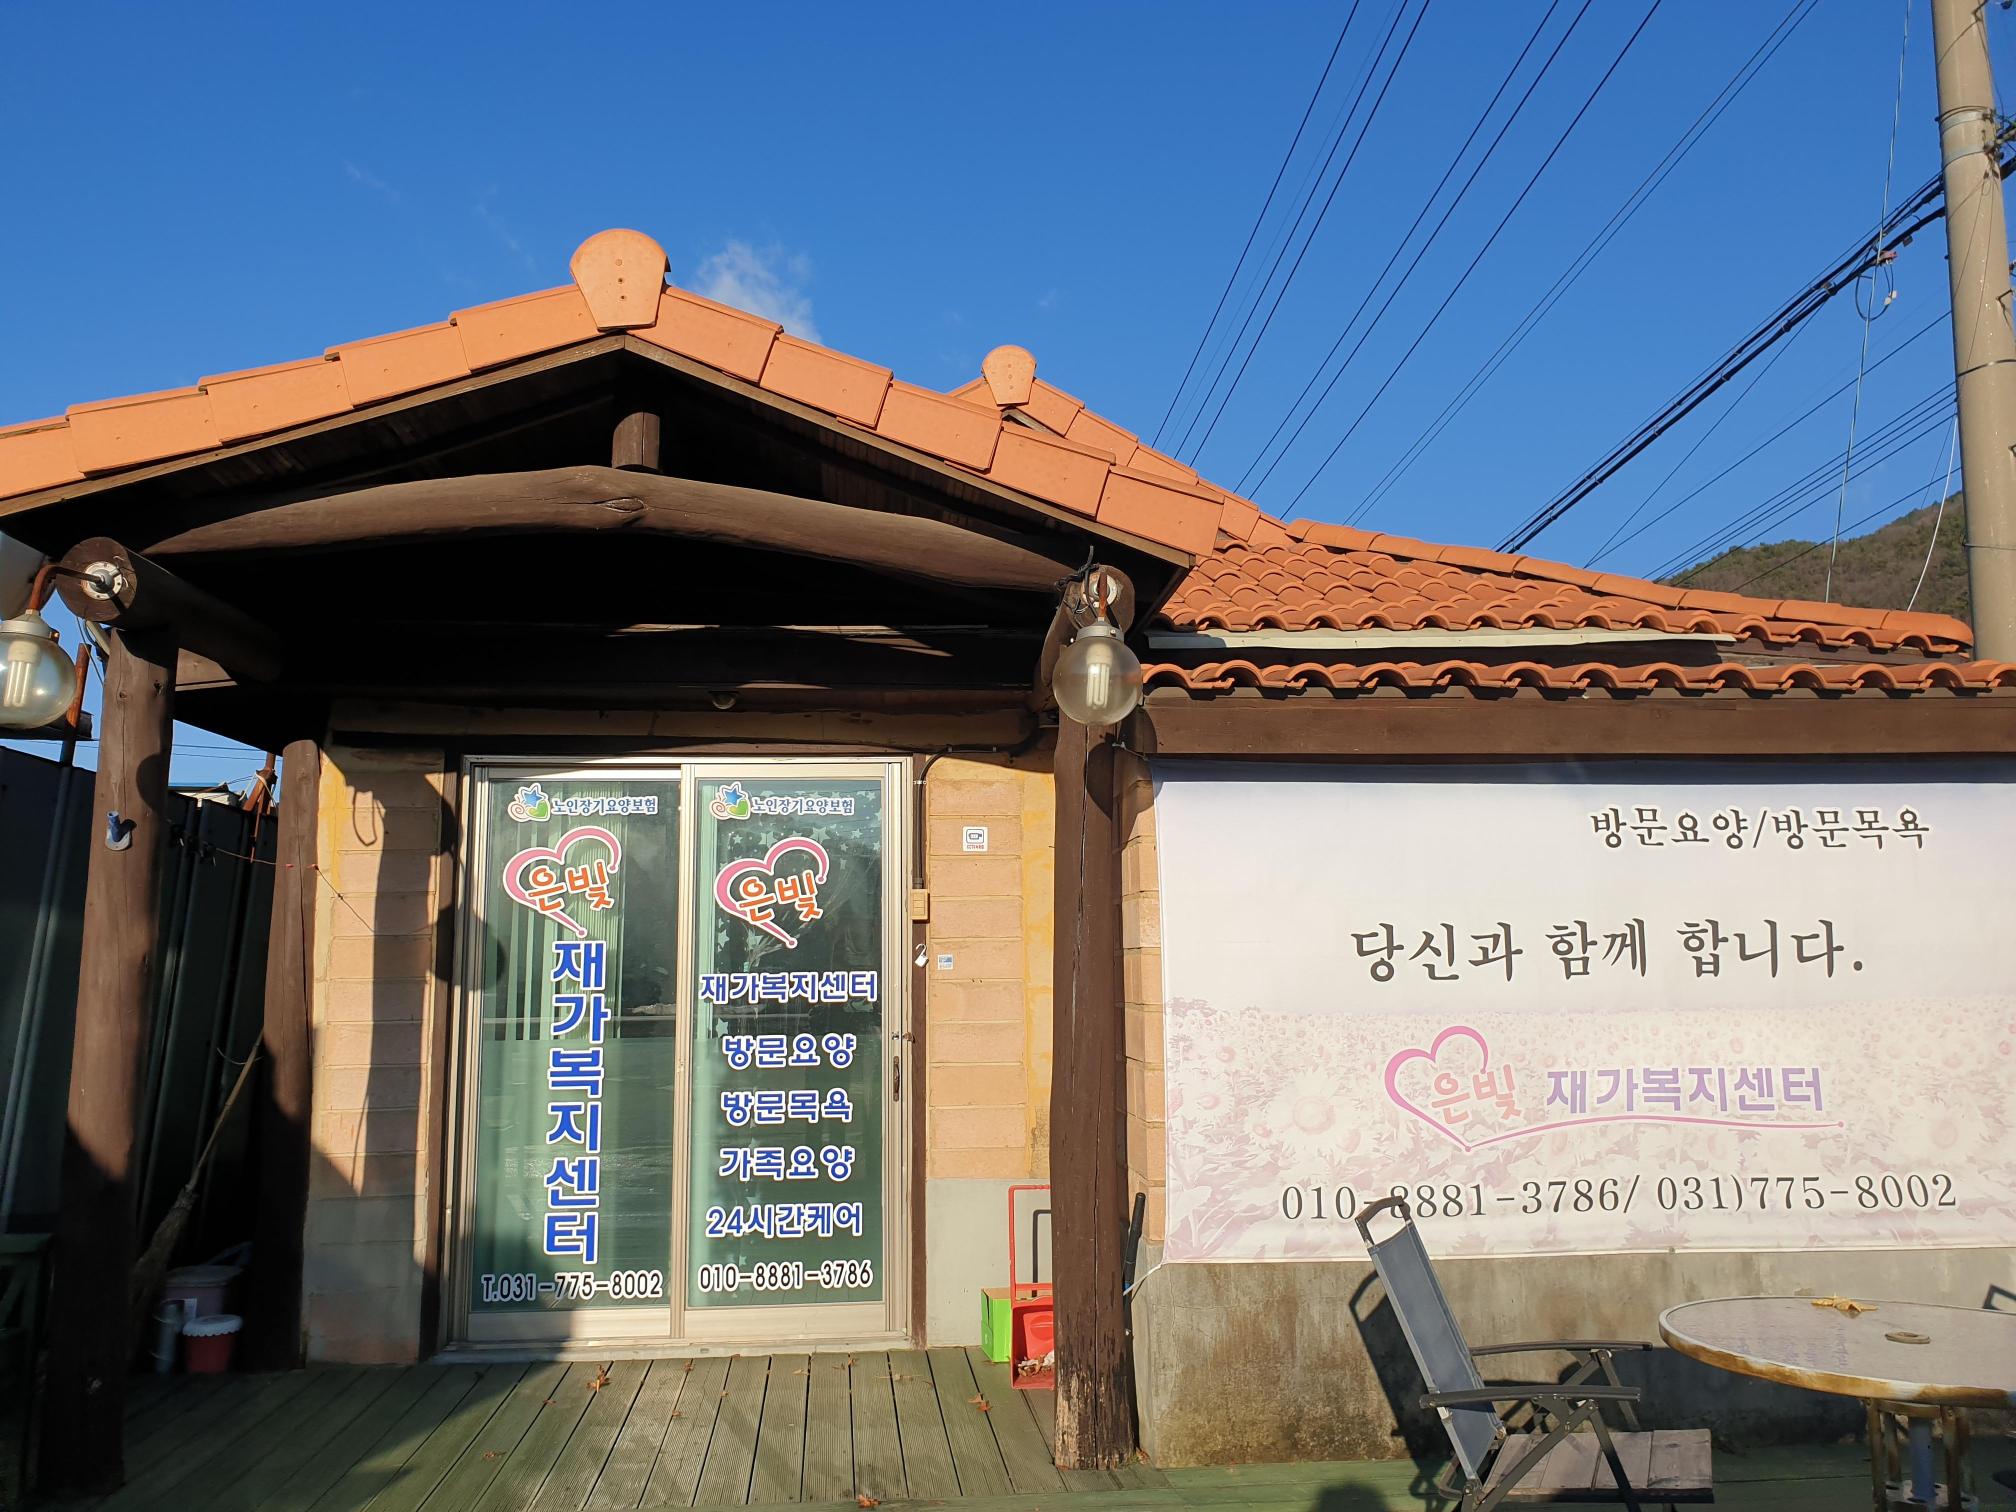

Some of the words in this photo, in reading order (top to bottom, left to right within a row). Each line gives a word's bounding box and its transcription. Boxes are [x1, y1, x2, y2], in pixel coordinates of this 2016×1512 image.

[552, 798, 657, 814] 노인장기요양보험
[752, 797, 855, 815] 노인장기요양보험
[1591, 808, 1930, 850] 방문요양/방문목욕
[528, 862, 612, 912] 은빛
[738, 872, 823, 922] 은빛
[1351, 922, 1523, 982] 당신과
[1546, 918, 1648, 979] 함께
[1677, 918, 1864, 979] 합니다.
[700, 973, 877, 1002] 재가복지센터
[723, 1034, 855, 1067] 방문요양
[544, 942, 610, 1262] 재가복지센터
[722, 1089, 852, 1124] 방문목욕
[1430, 1064, 1518, 1123] 은빛
[1546, 1067, 1824, 1114] 재가복지센터
[721, 1147, 855, 1180] 가족요양
[707, 1204, 862, 1236] 24시간케어
[482, 1273, 662, 1299] T.031-775-8002
[701, 1263, 871, 1290] 010-8881-3786
